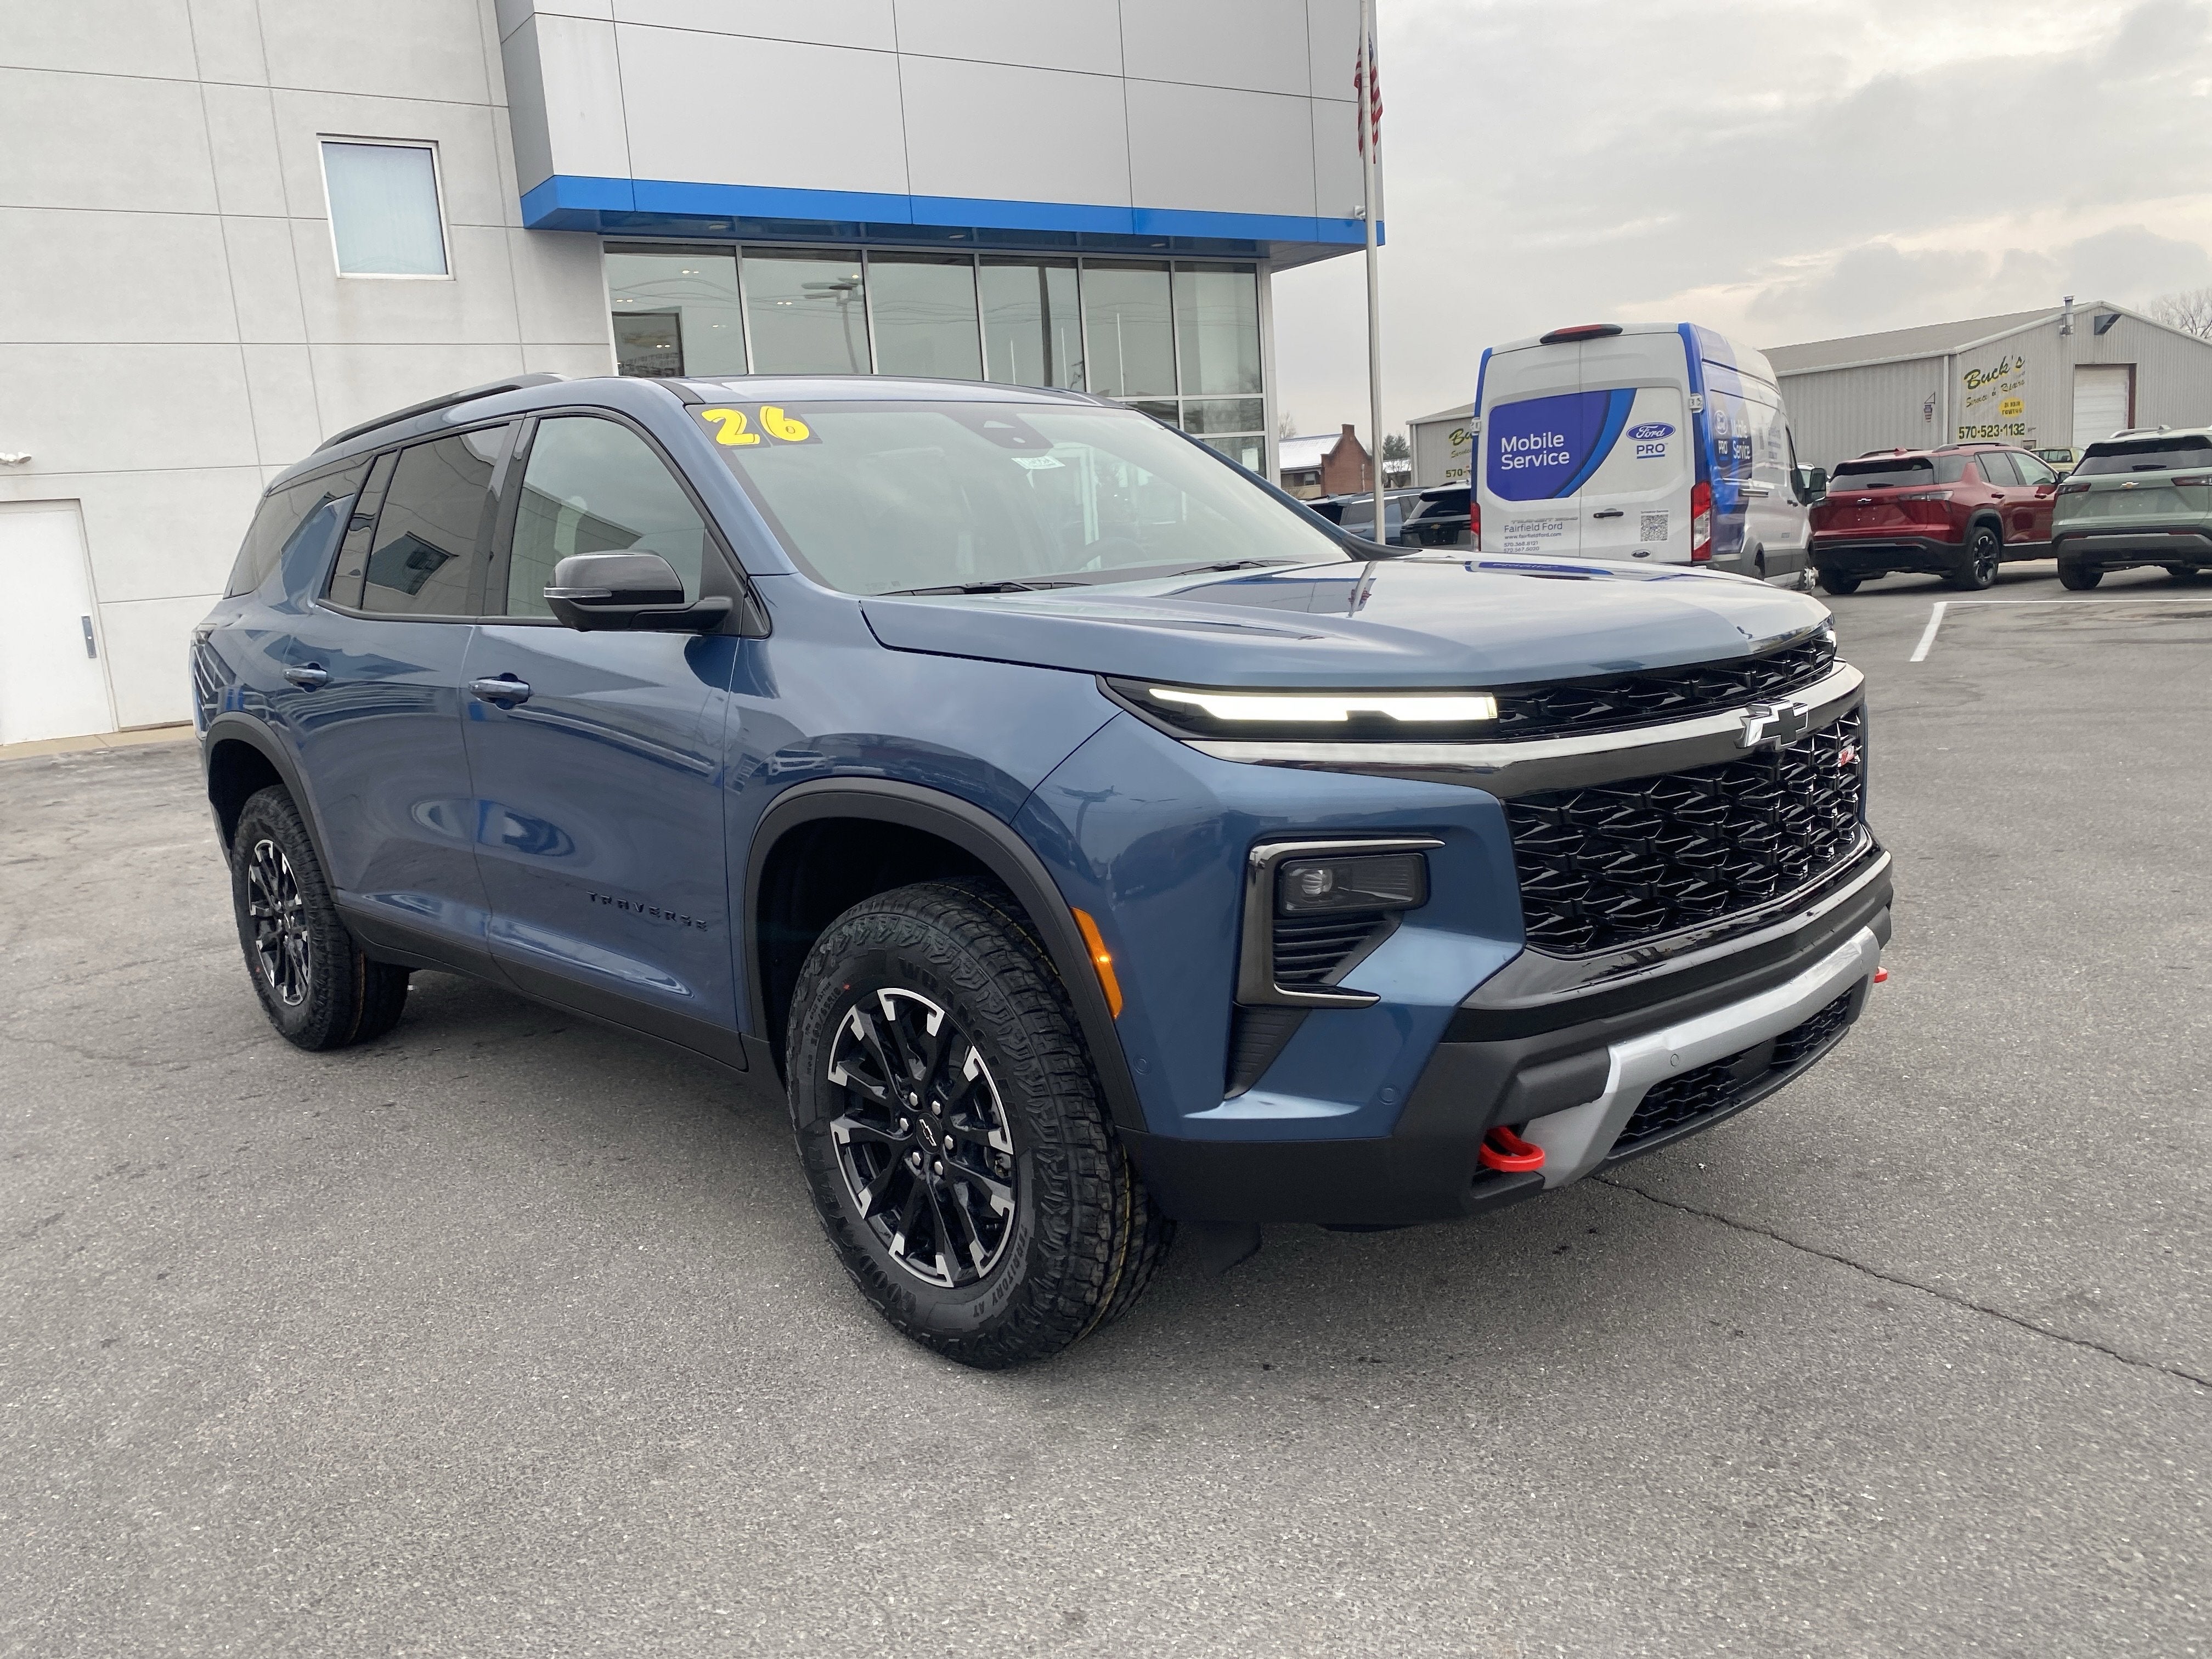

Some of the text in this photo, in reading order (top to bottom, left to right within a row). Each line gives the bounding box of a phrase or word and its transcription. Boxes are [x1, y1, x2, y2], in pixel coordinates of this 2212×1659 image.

[1964, 355, 2025, 390] Buck's
[701, 406, 809, 446] 26
[1501, 431, 1564, 453] Mobile
[1637, 443, 1665, 454] PRO
[1718, 441, 1728, 455] PRO
[1733, 441, 1750, 459] Service
[1501, 450, 1570, 470] Service
[1504, 522, 1563, 533] Fairfield Ford
[586, 890, 708, 932] TRAVERSE
[808, 1145, 917, 1315] GOODYEAR
[973, 1223, 1028, 1318] TERRITORY AT
